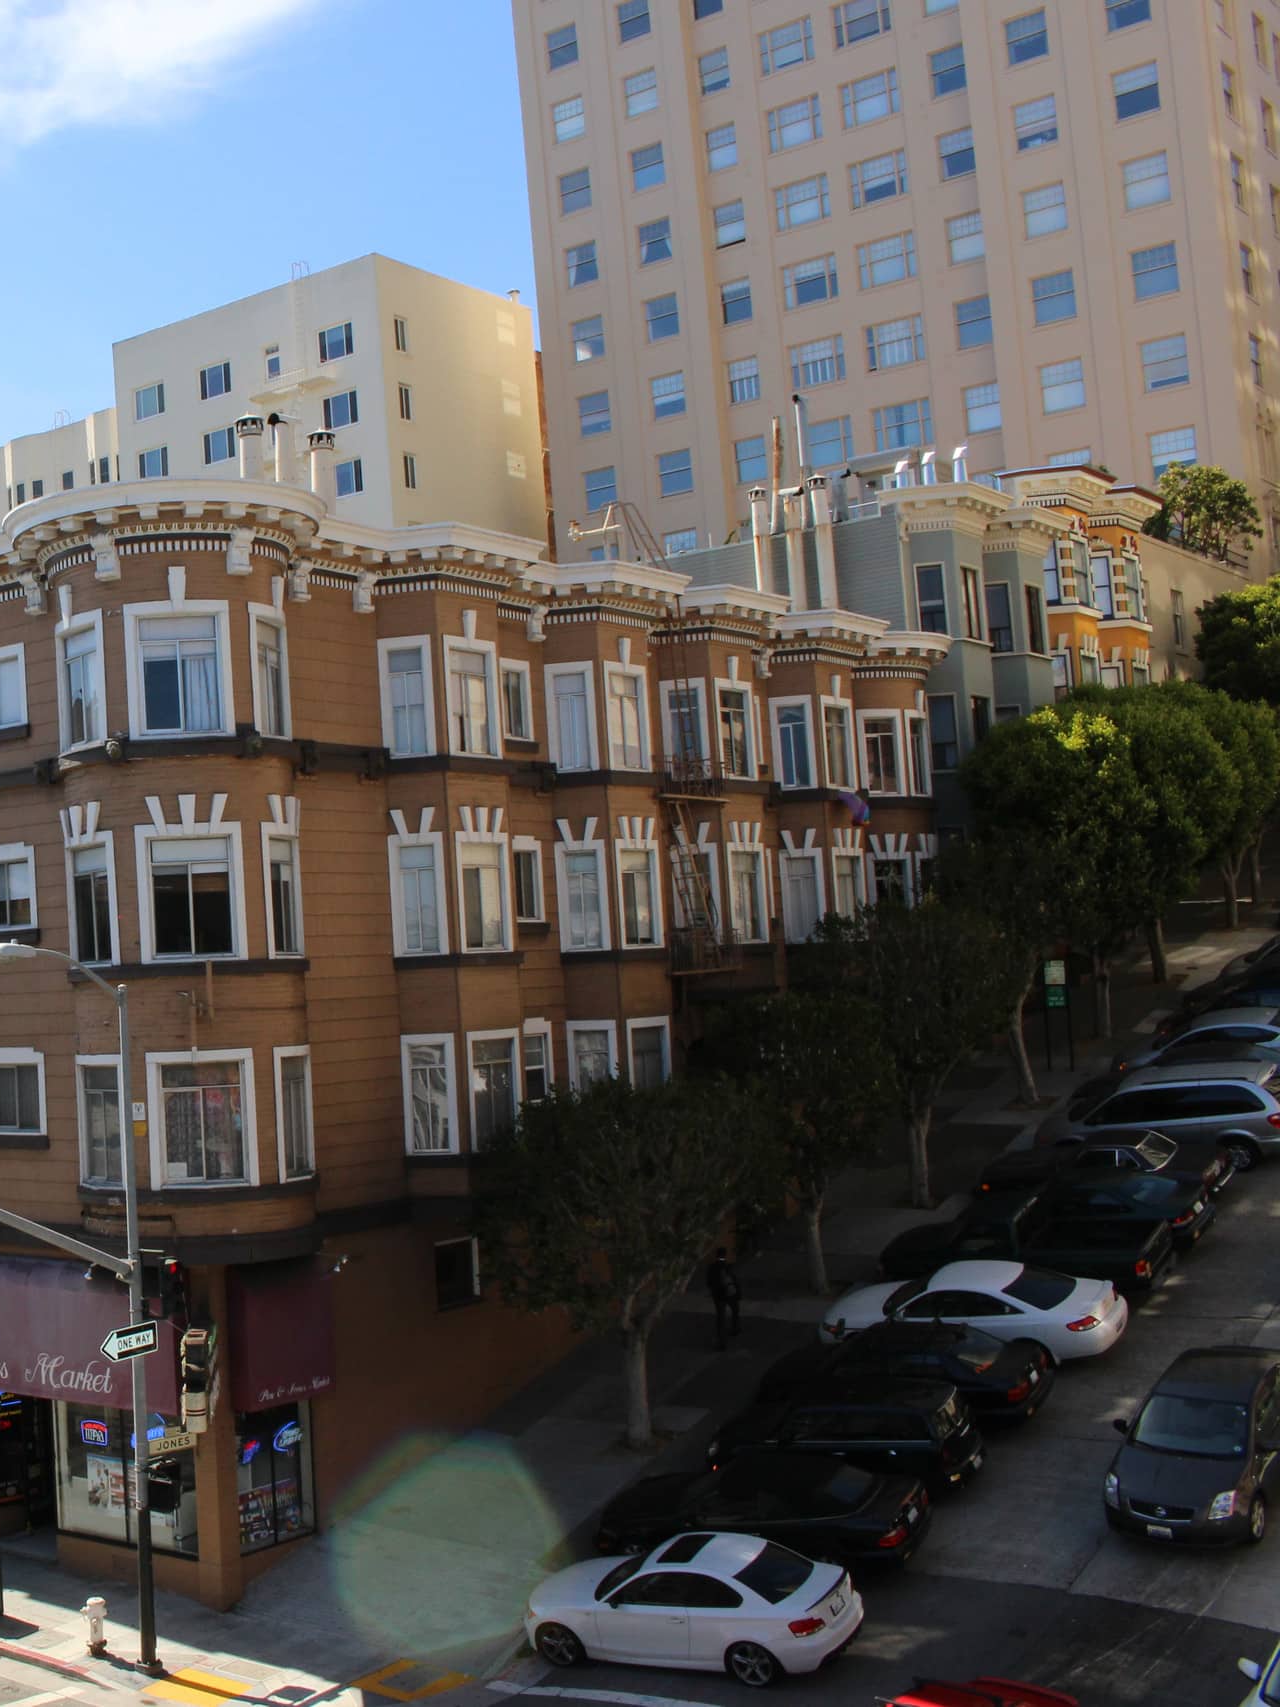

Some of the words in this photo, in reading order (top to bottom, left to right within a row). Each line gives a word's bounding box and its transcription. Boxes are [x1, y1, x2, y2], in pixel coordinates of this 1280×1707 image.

[117, 1338, 134, 1350] ONE
[135, 1333, 151, 1345] WAY
[25, 1353, 112, 1394] Market
[157, 1436, 191, 1451] JONES
